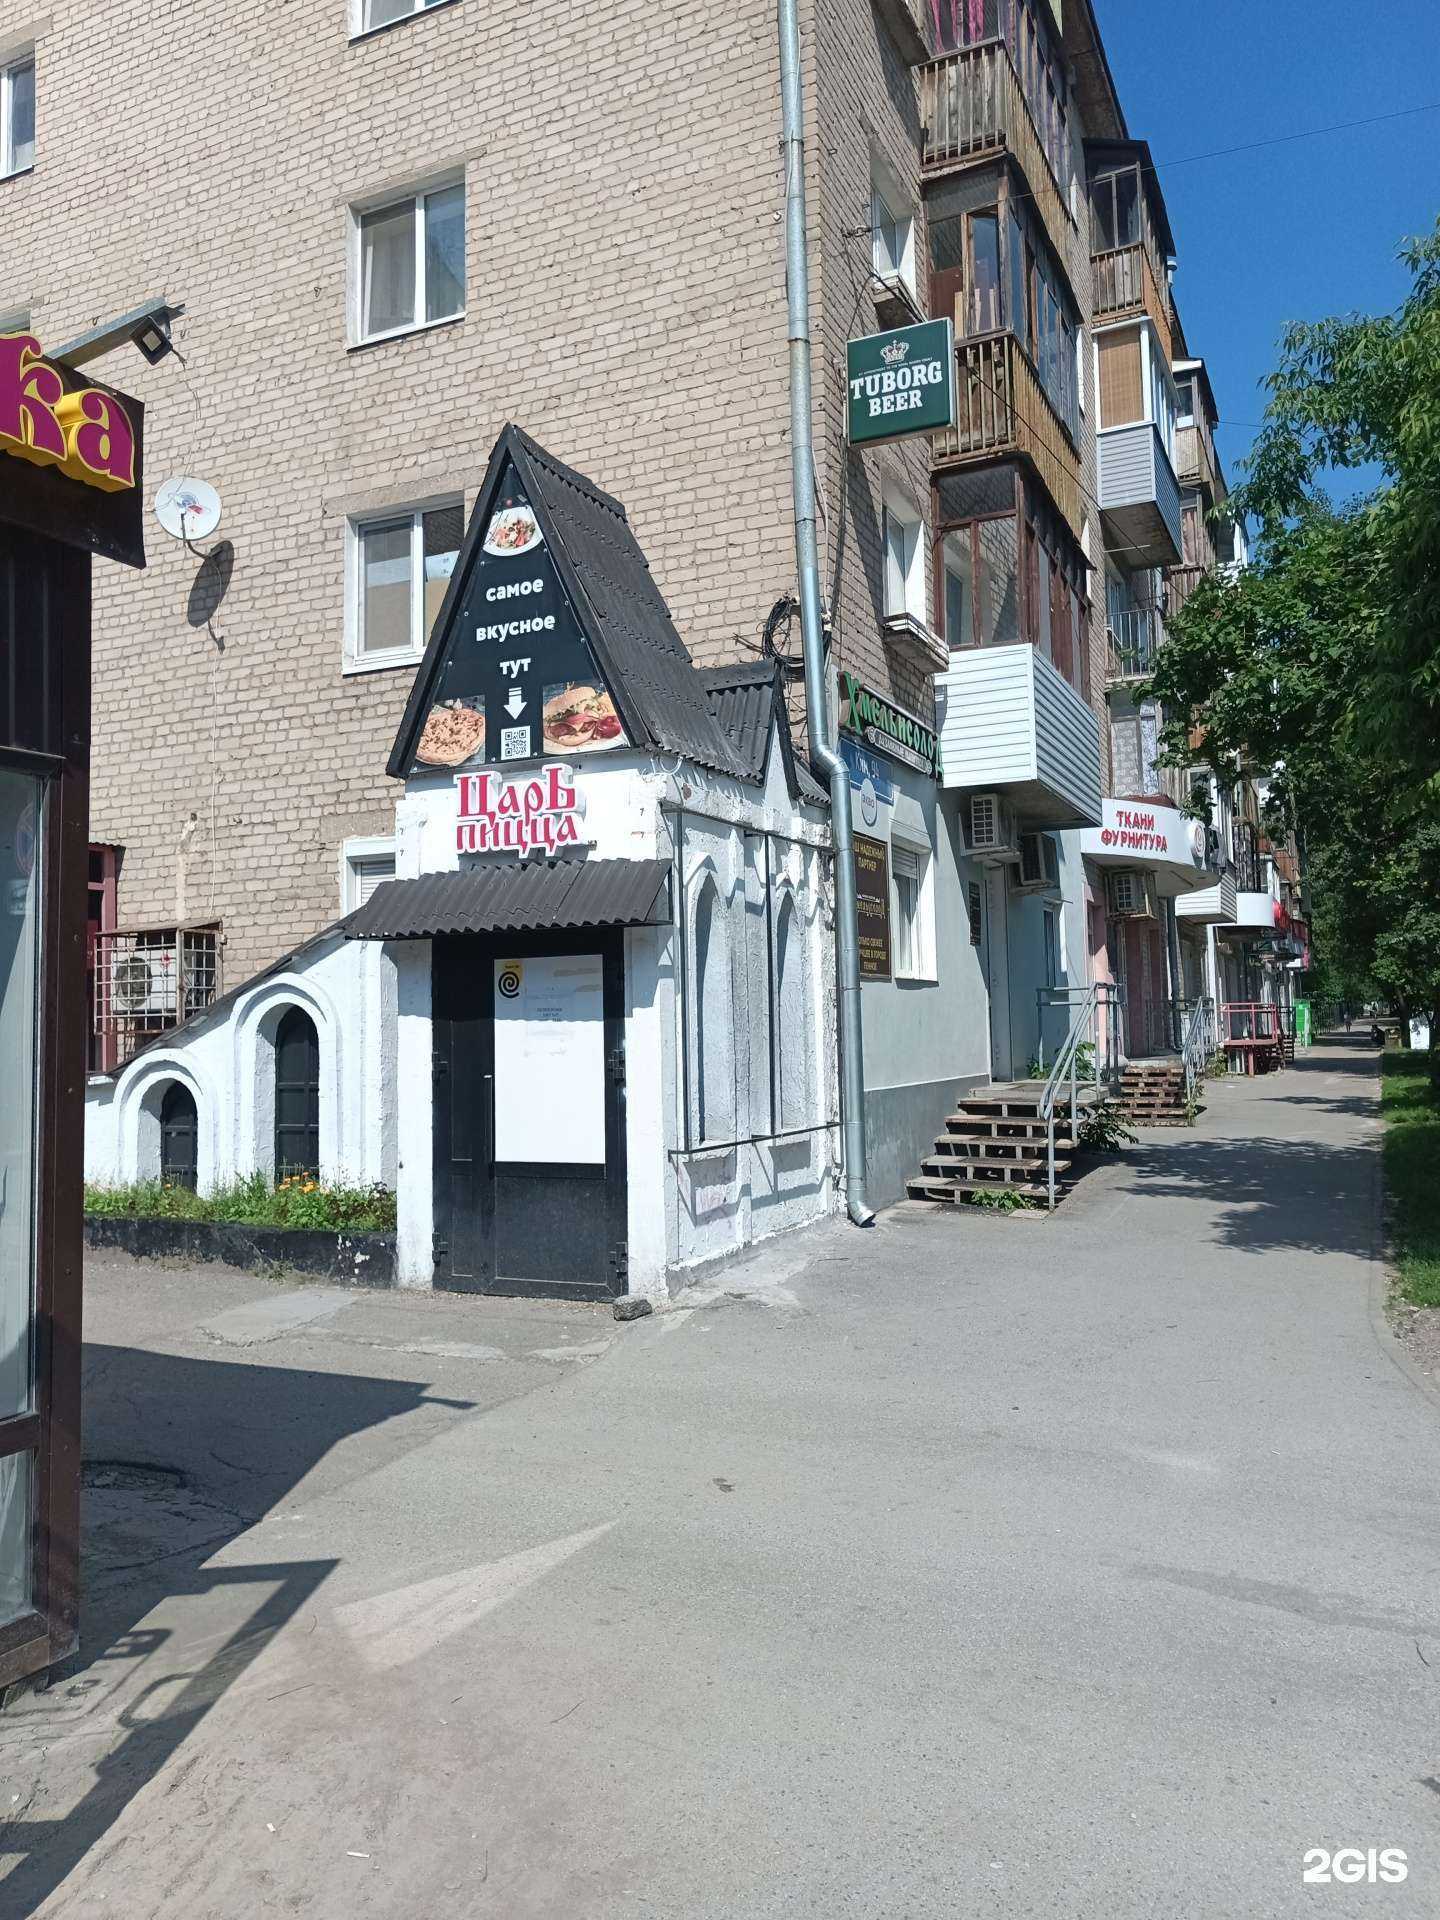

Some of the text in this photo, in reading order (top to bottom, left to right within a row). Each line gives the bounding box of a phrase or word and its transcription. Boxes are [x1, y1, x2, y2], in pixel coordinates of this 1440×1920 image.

[849, 361, 943, 400] TUBORG
[868, 389, 923, 417] BEER
[485, 577, 544, 602] самое
[475, 614, 556, 643] вкусное
[499, 657, 532, 679] тут
[1116, 811, 1155, 831] ТКАНИ
[1101, 829, 1168, 853] ФУРНИТУРА
